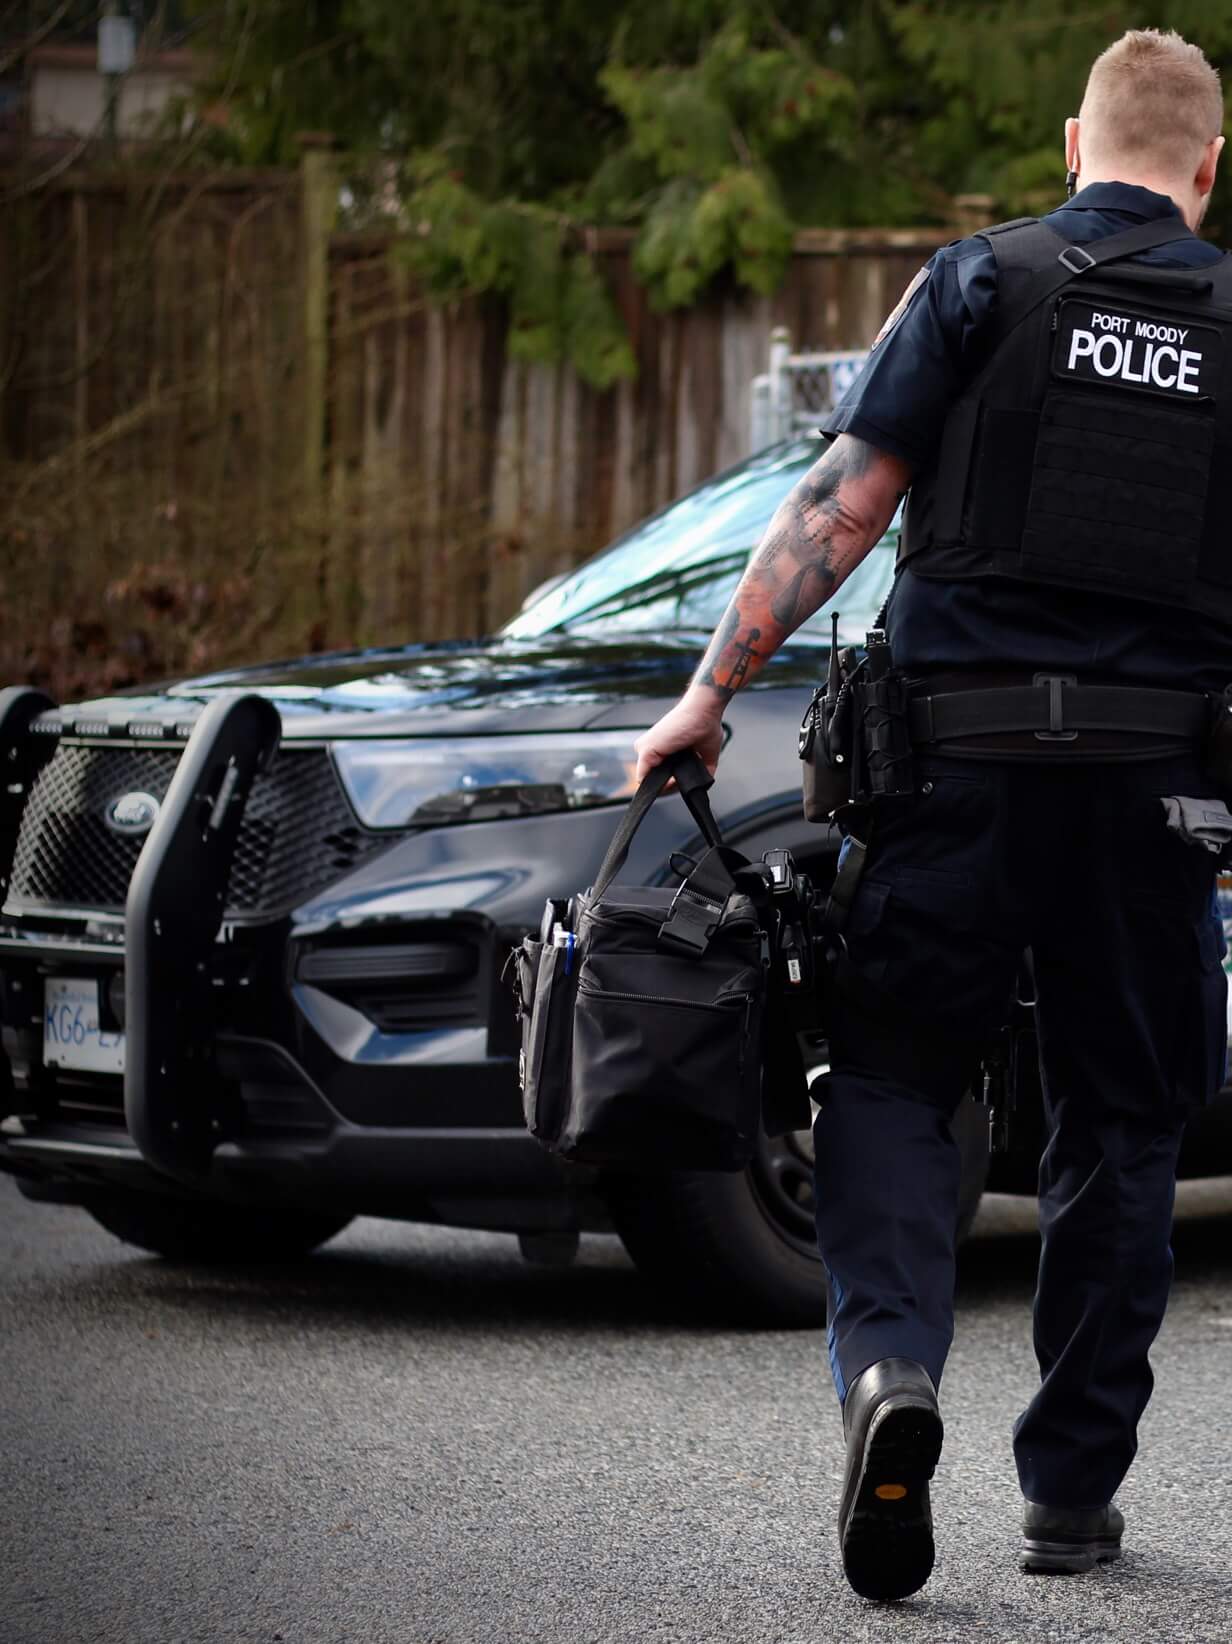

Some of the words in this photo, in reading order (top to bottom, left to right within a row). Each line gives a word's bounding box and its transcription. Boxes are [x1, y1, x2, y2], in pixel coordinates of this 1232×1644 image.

[1091, 312, 1131, 334] PORT
[1135, 321, 1189, 345] MOODY
[1067, 328, 1203, 394] POLICE
